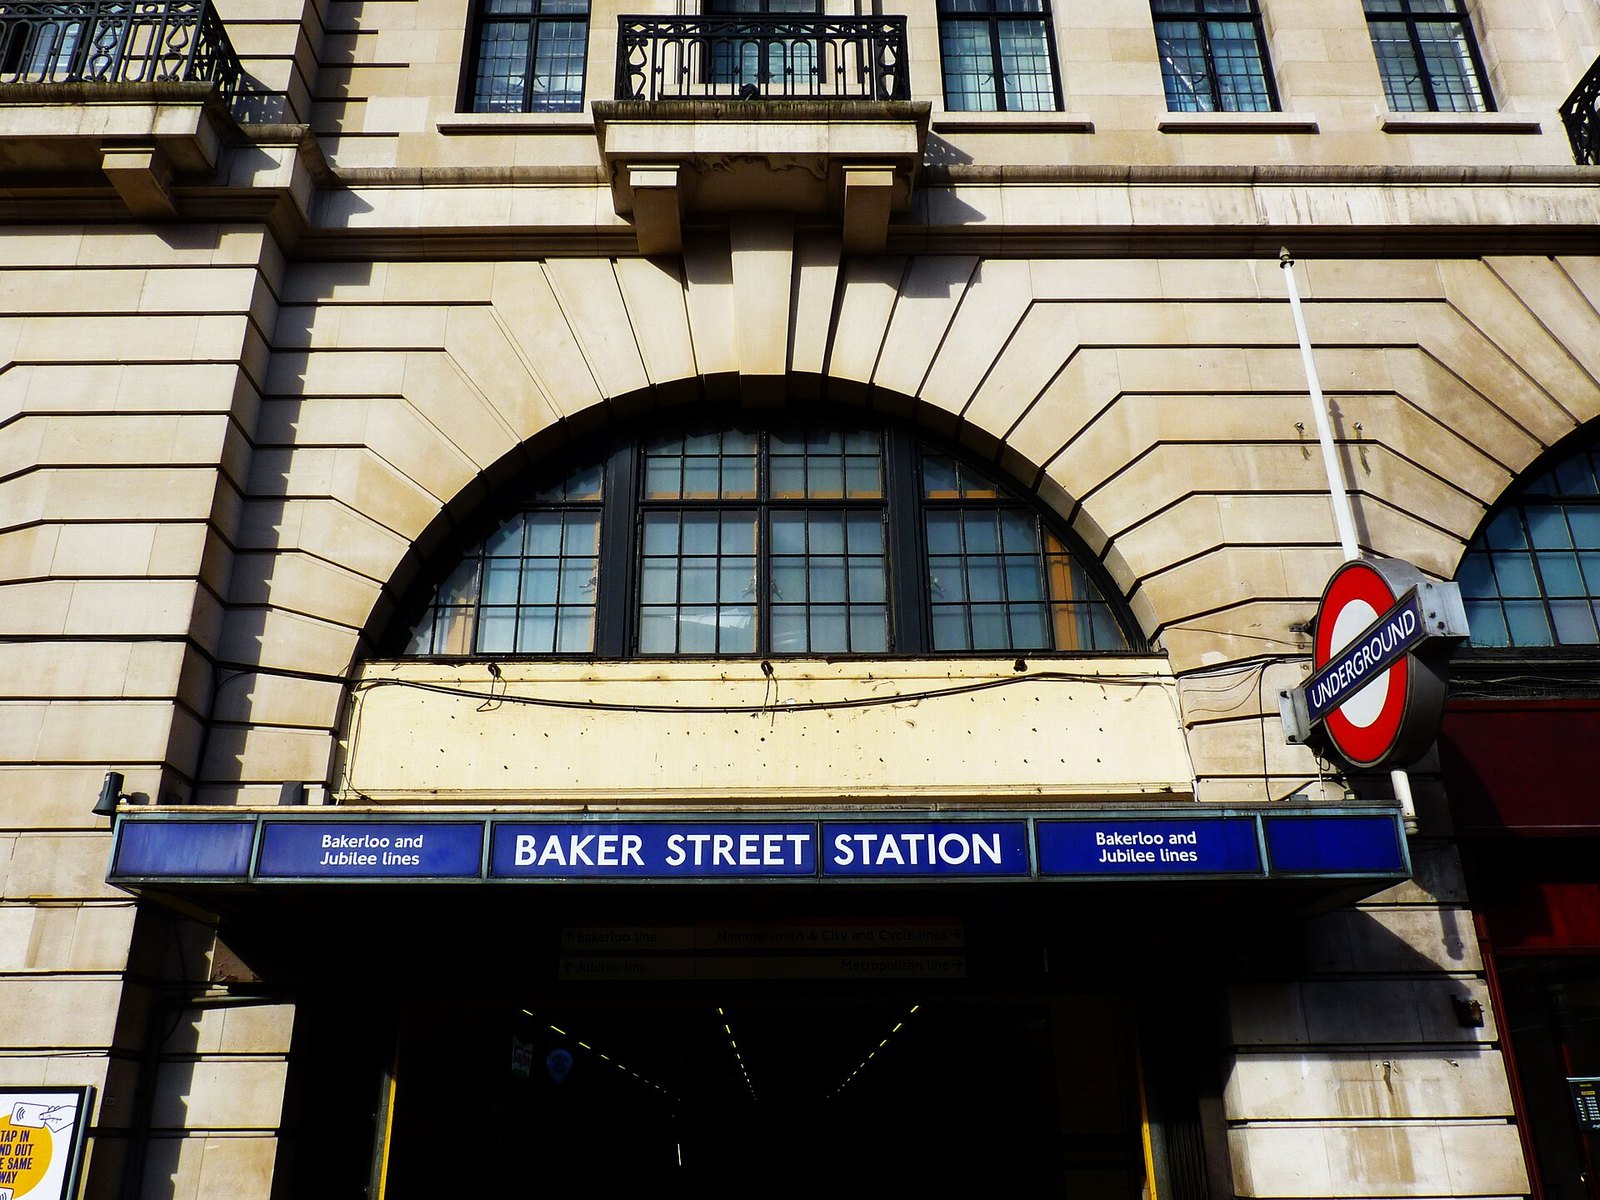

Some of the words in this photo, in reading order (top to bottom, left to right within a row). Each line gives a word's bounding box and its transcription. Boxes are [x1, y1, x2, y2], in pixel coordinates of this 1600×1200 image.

[1312, 609, 1415, 708] UNDERGROUND
[322, 834, 389, 848] Bakerloo
[395, 834, 423, 848] and
[1096, 831, 1164, 845] Bakerloo
[1169, 831, 1197, 844] and
[514, 834, 645, 866] BAKER
[665, 834, 810, 866] STREET
[834, 833, 1002, 866] STATION
[1099, 848, 1155, 863] Jubilee
[1160, 848, 1198, 862] lines
[320, 851, 377, 866] Jubilee
[382, 851, 420, 866] lines
[576, 930, 631, 943] Bakerloo
[635, 930, 657, 942] line
[717, 929, 804, 942] Hammersmith
[809, 929, 817, 941] &
[822, 929, 848, 943] City
[851, 929, 874, 941] and
[879, 929, 914, 941] Circle
[919, 929, 948, 940] lines
[575, 960, 621, 973] Jubilee
[625, 960, 648, 973] line
[840, 959, 922, 973] Metropolitan
[927, 959, 949, 971] line
[1, 1130, 18, 1142] TAP
[20, 1130, 30, 1142] IN
[0, 1144, 12, 1156] ND
[15, 1144, 34, 1156] OUT
[7, 1157, 33, 1170] SAME
